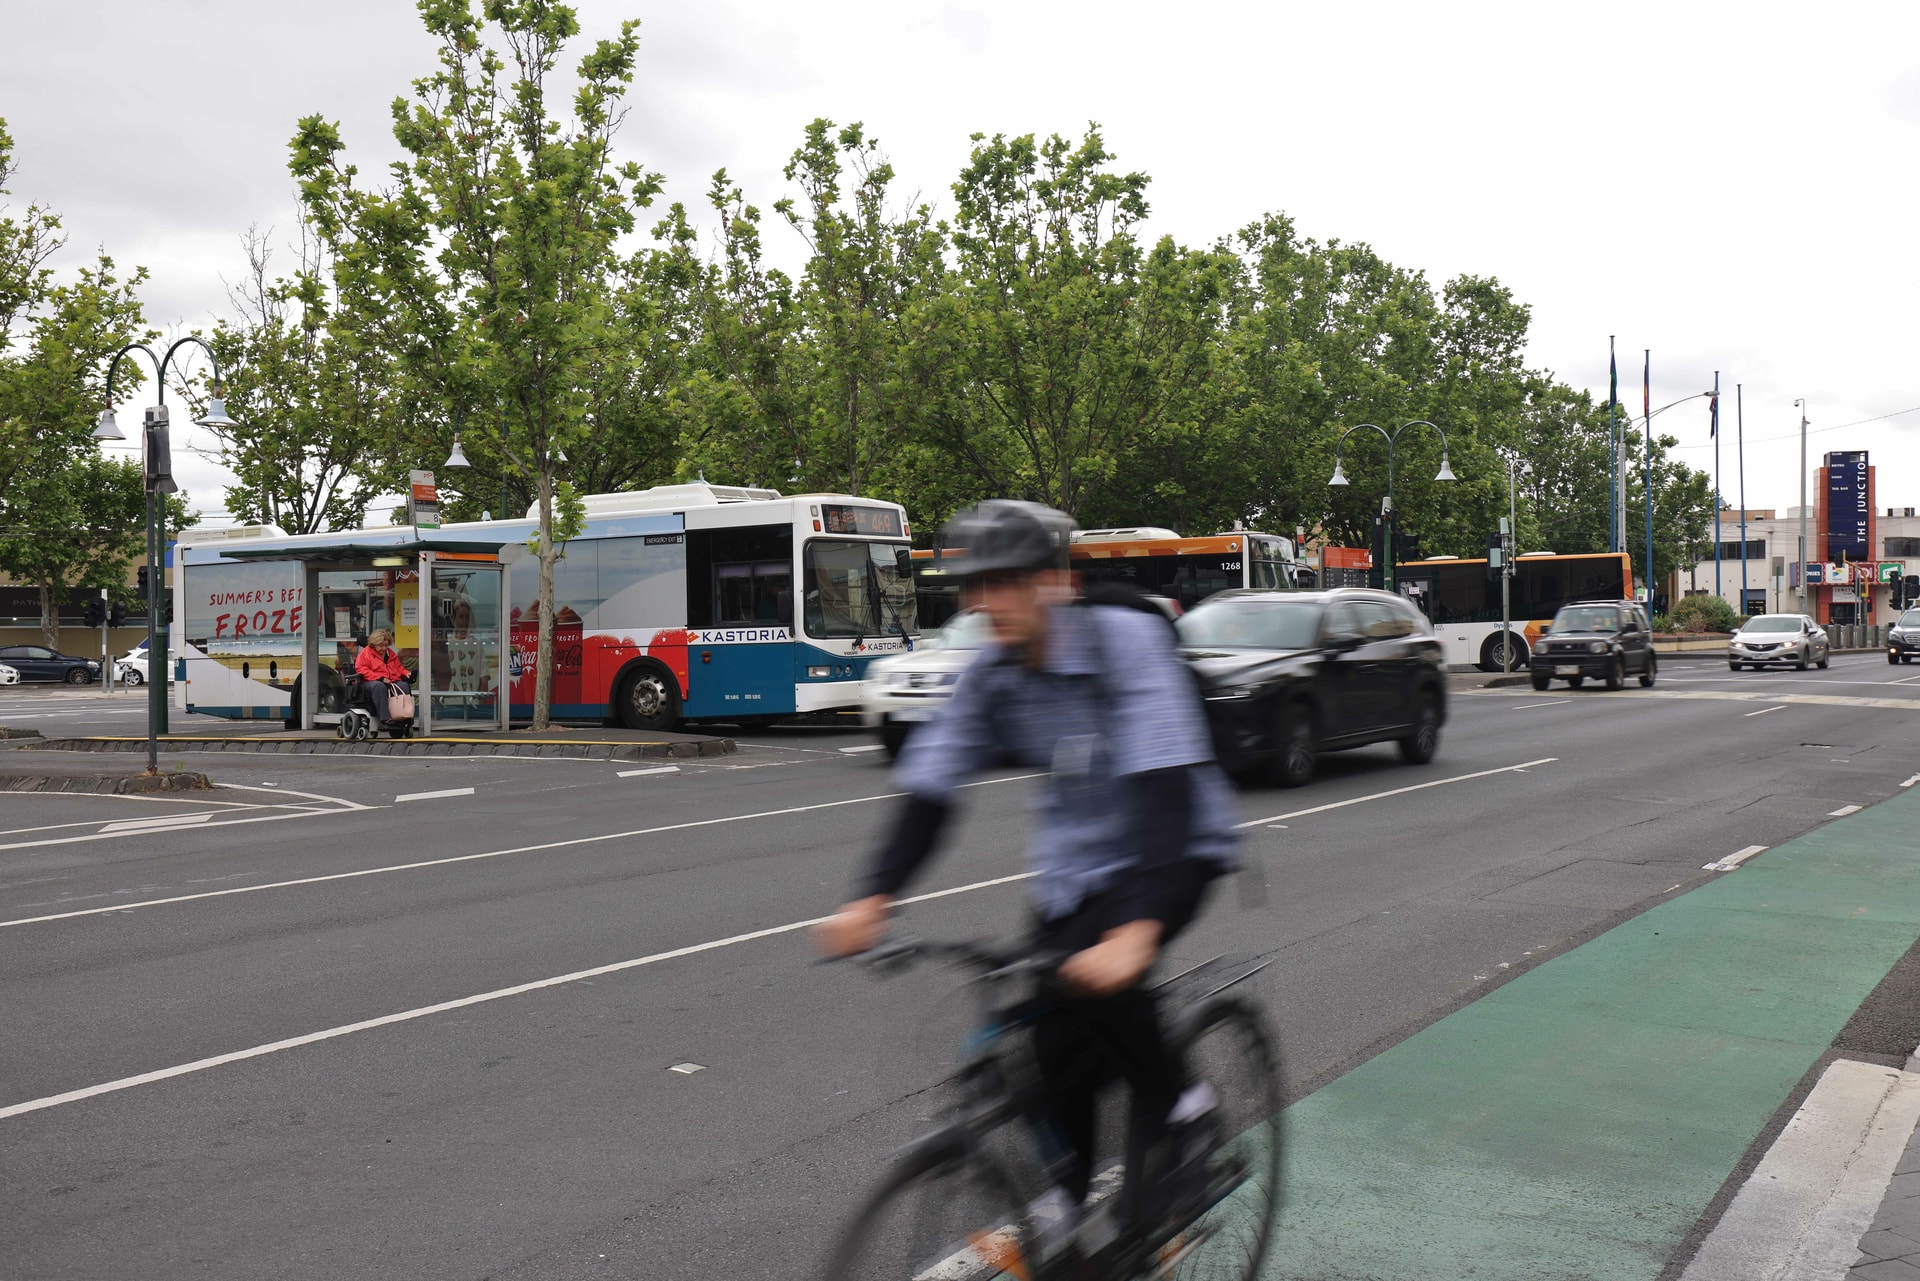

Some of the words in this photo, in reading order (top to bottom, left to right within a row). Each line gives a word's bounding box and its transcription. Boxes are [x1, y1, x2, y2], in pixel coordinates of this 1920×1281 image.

[433, 513, 439, 522] 8
[871, 513, 892, 534] 469
[1857, 520, 1866, 543] THE
[1220, 562, 1241, 570] 1268
[209, 589, 274, 606] SUMMER'S
[215, 605, 323, 640] FROZE
[702, 629, 788, 643] KASTORIA
[867, 641, 904, 652] KASTORIA
